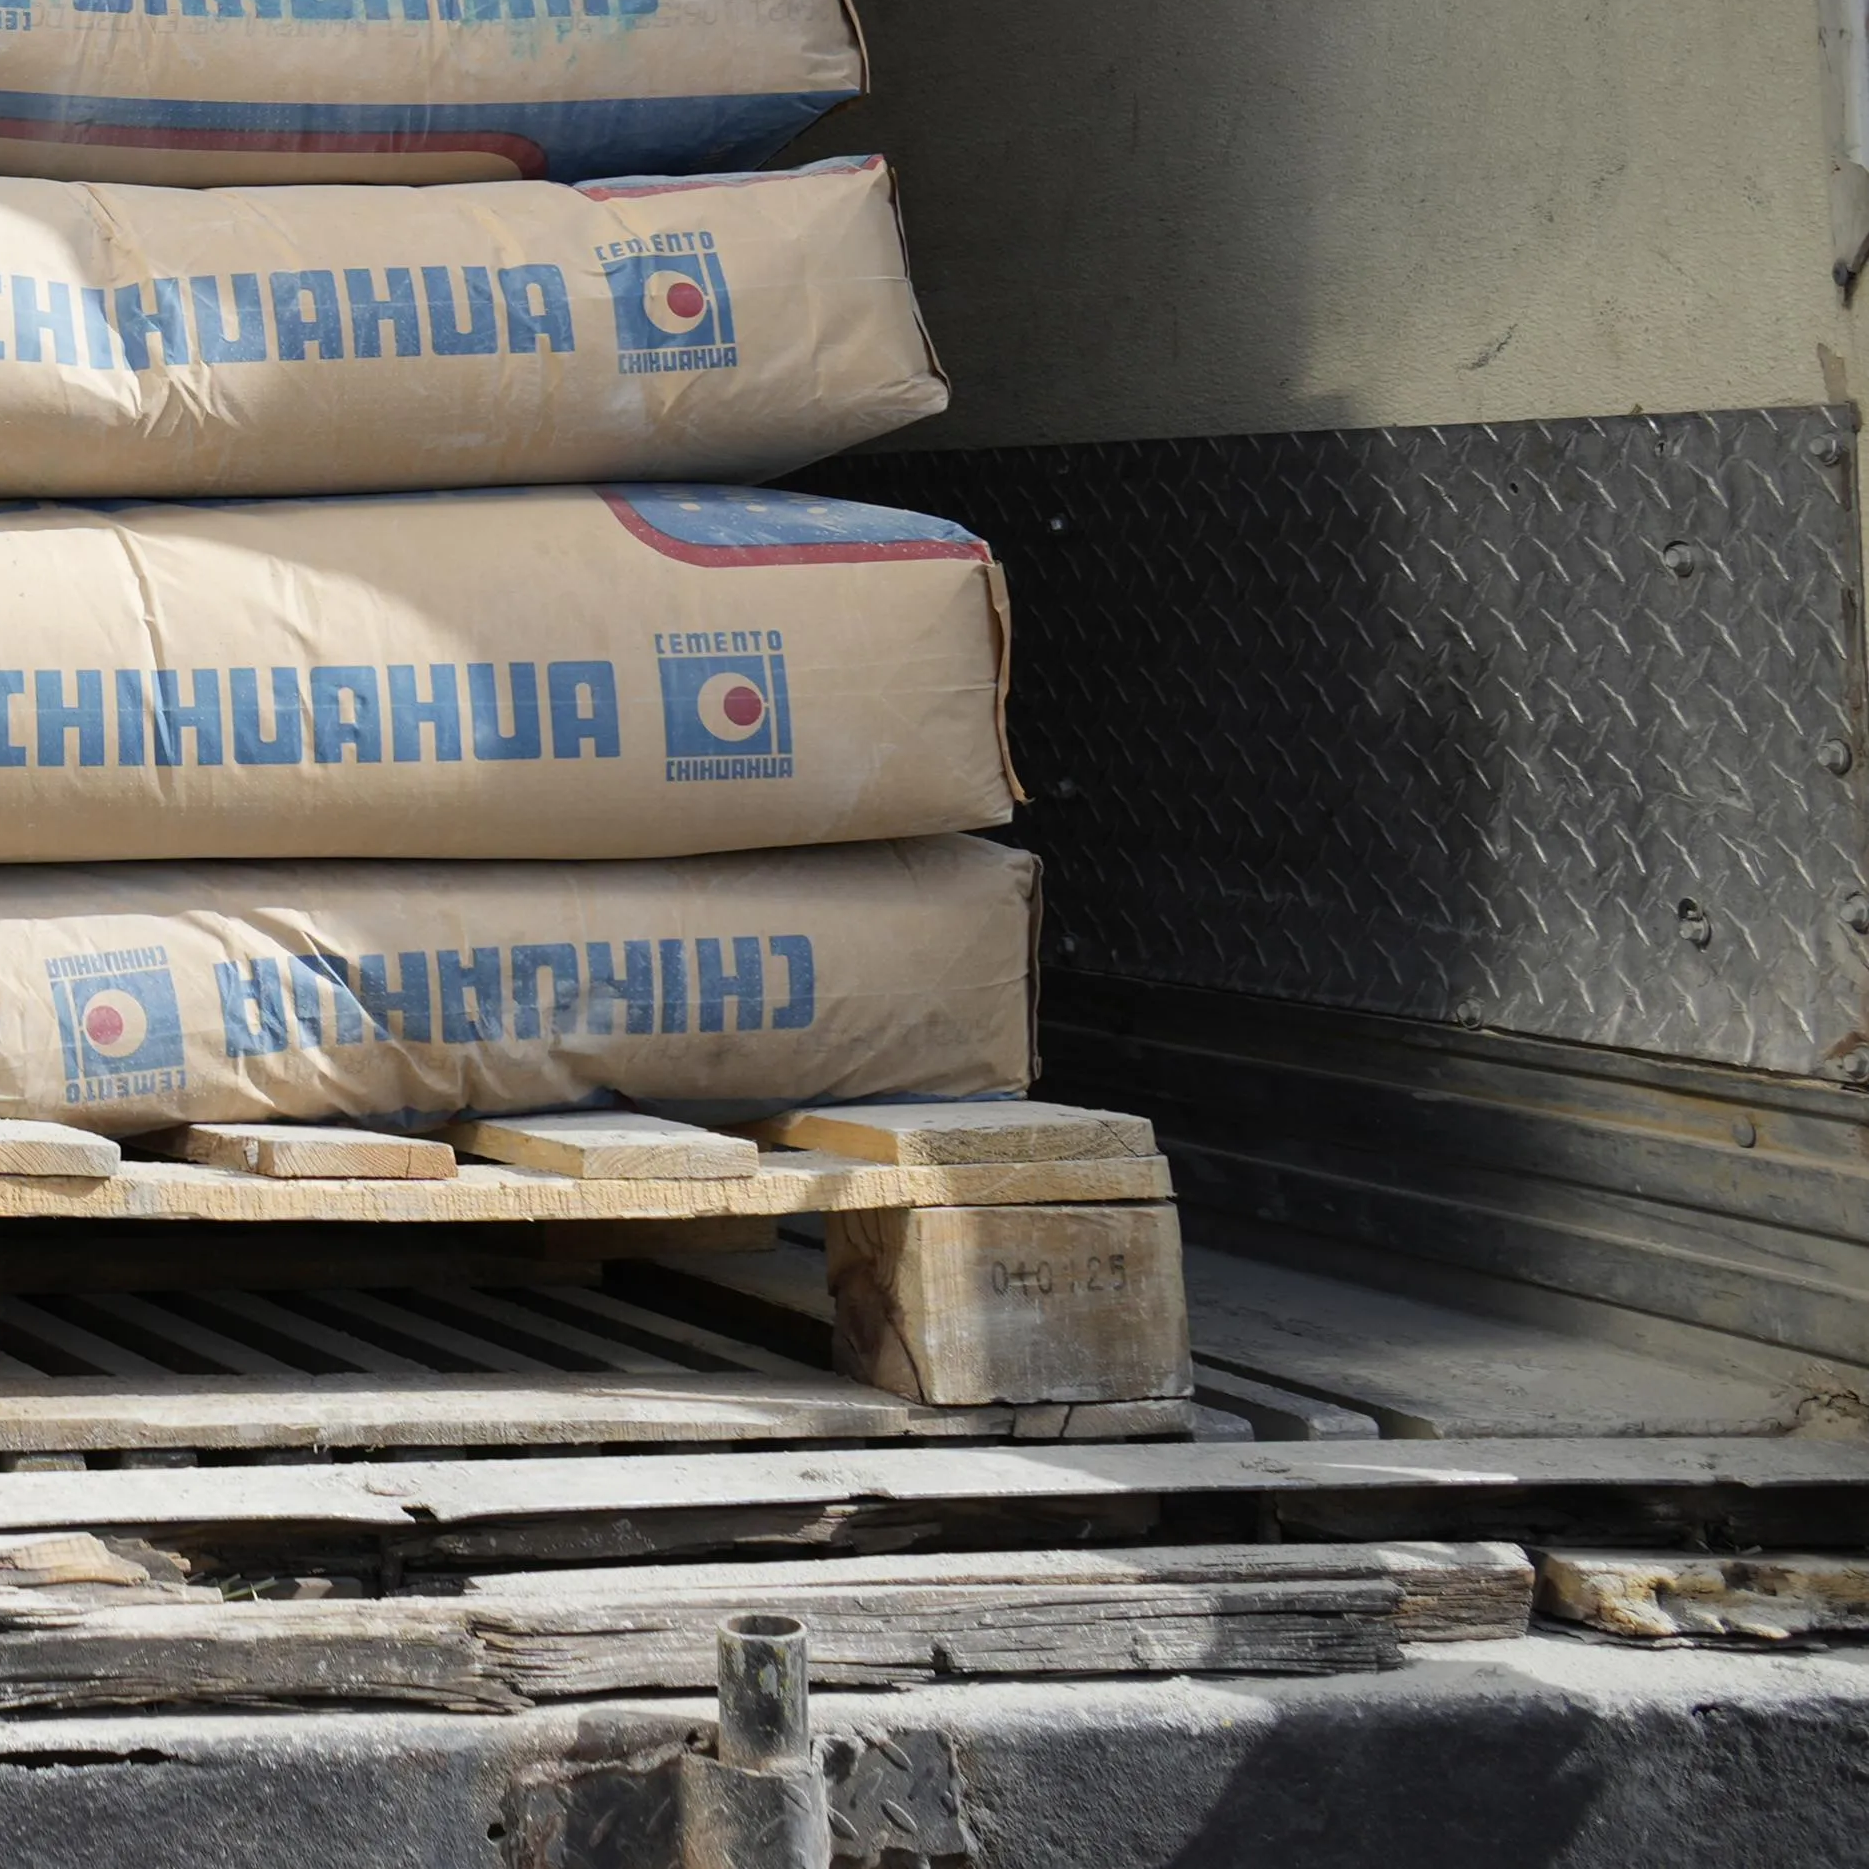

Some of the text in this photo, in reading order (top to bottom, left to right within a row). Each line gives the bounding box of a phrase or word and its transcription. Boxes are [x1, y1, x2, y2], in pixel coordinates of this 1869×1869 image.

[593, 230, 716, 261] CEMENTO
[617, 346, 737, 374] CHIHUAHUA
[655, 629, 783, 654] CEMENTO
[665, 755, 793, 782] CHIHUAHUA
[44, 944, 168, 980] CHIHUAHUA
[214, 933, 814, 1058] CHIHUAHUA
[64, 1069, 188, 1105] CEMENTO
